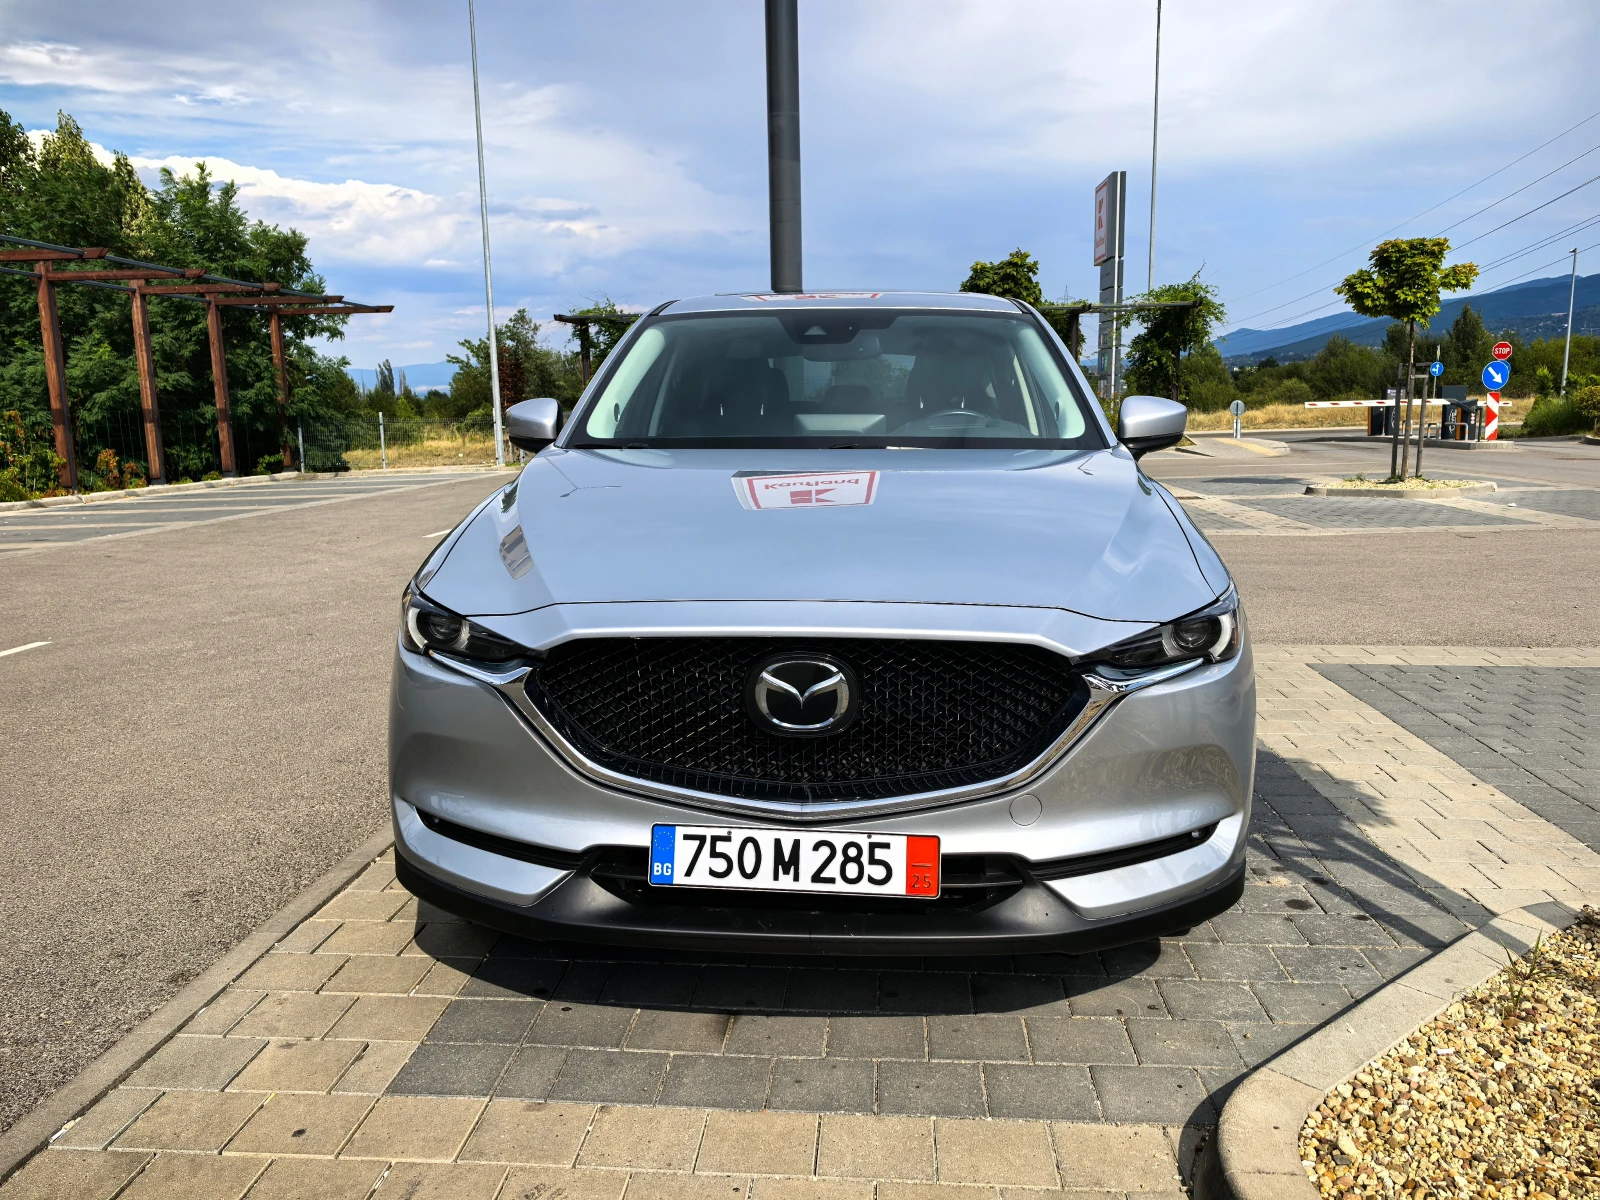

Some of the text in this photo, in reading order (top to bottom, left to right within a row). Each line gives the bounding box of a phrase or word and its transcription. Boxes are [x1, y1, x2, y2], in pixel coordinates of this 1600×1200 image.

[1494, 347, 1510, 355] STOP
[682, 833, 893, 886] 750 M 285
[653, 862, 672, 876] BG
[912, 874, 932, 889] 25
